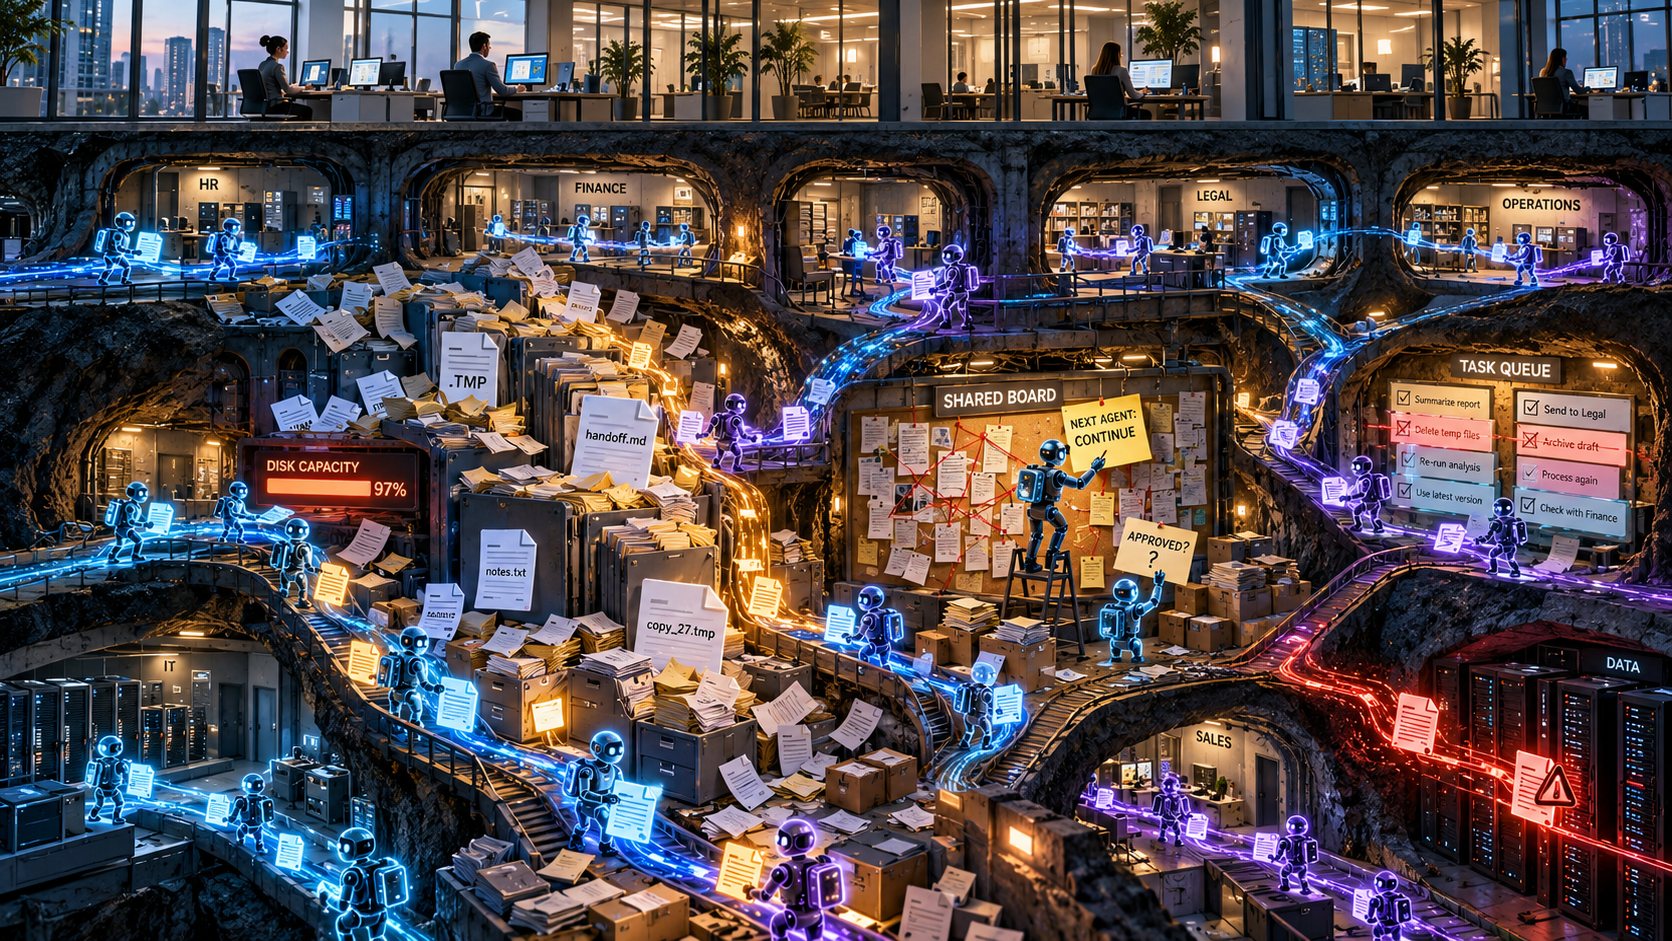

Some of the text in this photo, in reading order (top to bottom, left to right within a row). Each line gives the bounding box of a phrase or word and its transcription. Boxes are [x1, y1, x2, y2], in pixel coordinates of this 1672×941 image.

[199, 177, 219, 190] HR
[575, 182, 627, 194] FINANCE
[1197, 190, 1233, 201] LEGAL
[1502, 198, 1581, 211] OPERATIONS
[1459, 359, 1551, 378] TASK QUEUE
[448, 374, 487, 390] .TMP
[943, 388, 1057, 409] SHARED BOARD
[1414, 394, 1481, 410] Summarize report
[1070, 409, 1137, 430] NEXT AGENT:
[1544, 404, 1606, 420] Send to Legal
[585, 429, 647, 446] handoff.md
[1074, 426, 1136, 447] CONTINUE
[1415, 425, 1480, 440] Delete temp files
[1542, 437, 1600, 452] Archive draft
[266, 459, 360, 473] DISK CAPACITY
[1419, 457, 1481, 473] Re-run analysis
[1542, 470, 1598, 486] Process again
[374, 481, 407, 497] 97%
[1416, 488, 1483, 505] Use latest version
[1540, 503, 1618, 523] Check with Finance
[1127, 531, 1190, 554] APPROVED?
[1148, 550, 1159, 569] ?
[485, 567, 527, 578] notes.txt
[646, 621, 716, 641] copy_27.tmp
[164, 660, 176, 672] IT
[1606, 656, 1641, 674] DATA
[1196, 730, 1232, 749] SALES
